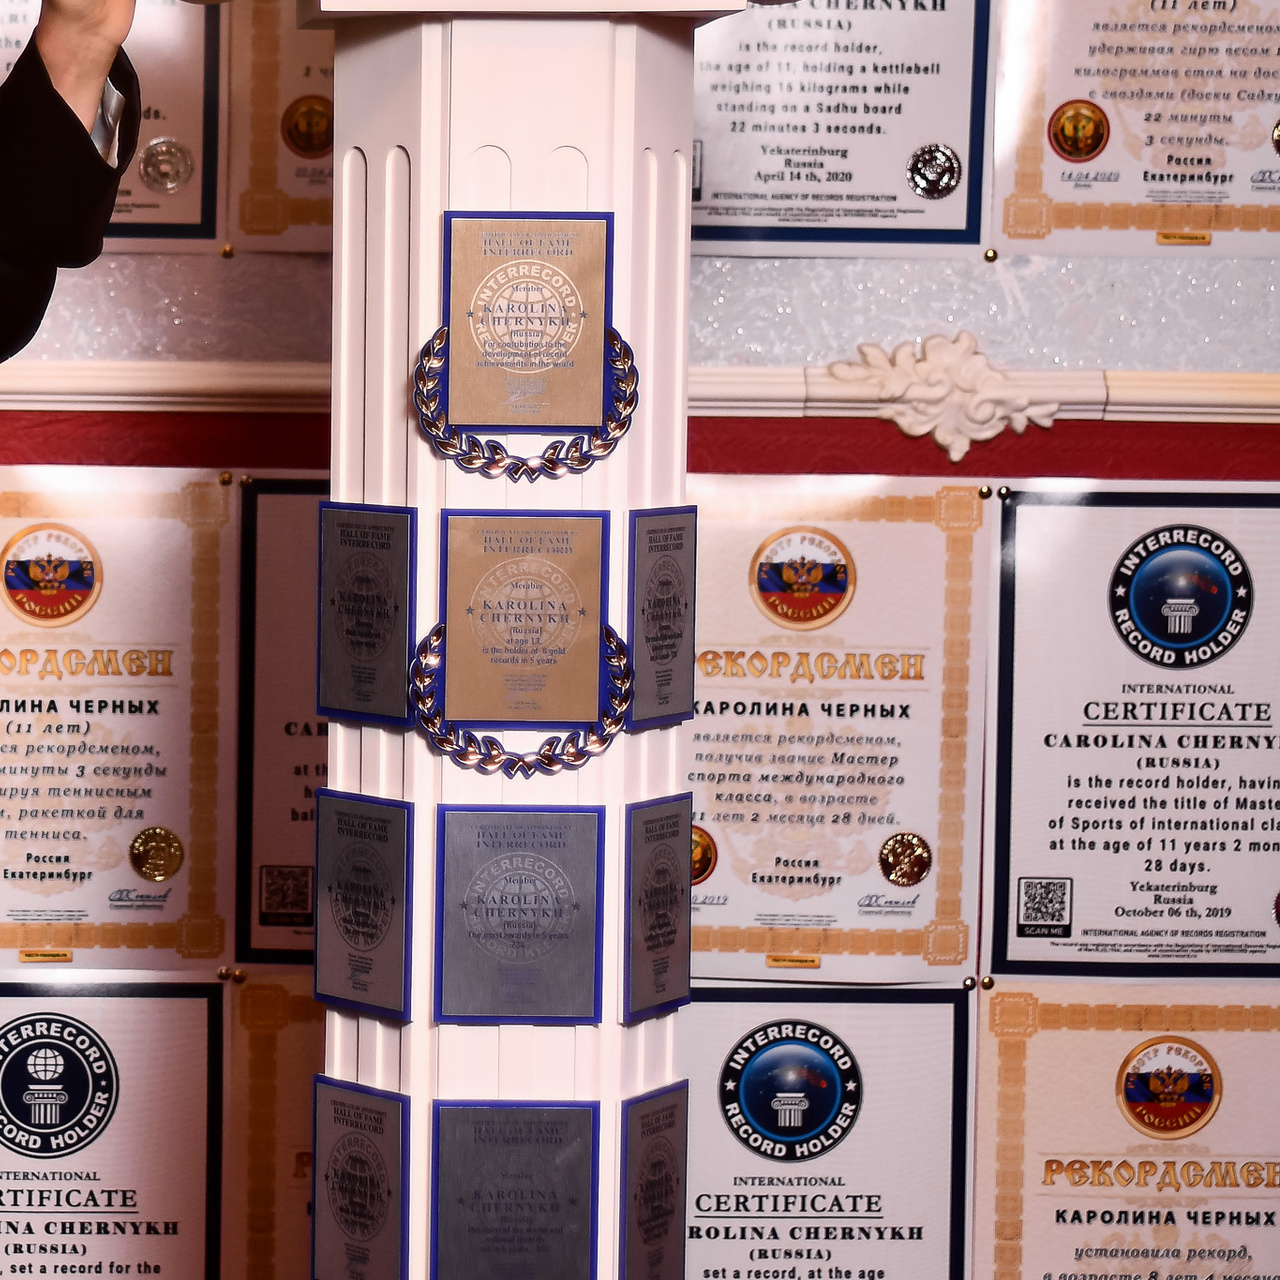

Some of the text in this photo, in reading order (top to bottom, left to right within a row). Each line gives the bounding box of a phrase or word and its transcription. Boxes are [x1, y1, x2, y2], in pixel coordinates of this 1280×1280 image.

[477, 264, 576, 308] INTERRECORD
[482, 303, 569, 314] KAROLINA
[480, 316, 571, 327] CHERNYKH
[1120, 529, 1244, 576] INTERRECORD
[482, 600, 568, 611] KAROLINA
[479, 613, 570, 624] CHERNYKH
[1115, 608, 1247, 665] RECORD HOLDER
[1121, 683, 1235, 695] INTERNATIONAL
[69, 698, 159, 714] ЧЕРНЫХ
[1083, 700, 1271, 721] CERTIFICATE
[5, 719, 91, 736] (11 лет)
[47, 786, 153, 799] теннисным
[1144, 857, 1211, 875] 28 days.
[1114, 905, 1232, 920] October 06 th, 2019
[50, 1091, 110, 1150] HOLDER
[733, 1175, 846, 1187] INTERNATIONAL
[694, 1193, 882, 1212] CERTIFICATE
[1055, 1208, 1276, 1227] КАРОЛИНА ЧЕРНЫХ
[43, 1220, 178, 1235] CHERNYKH
